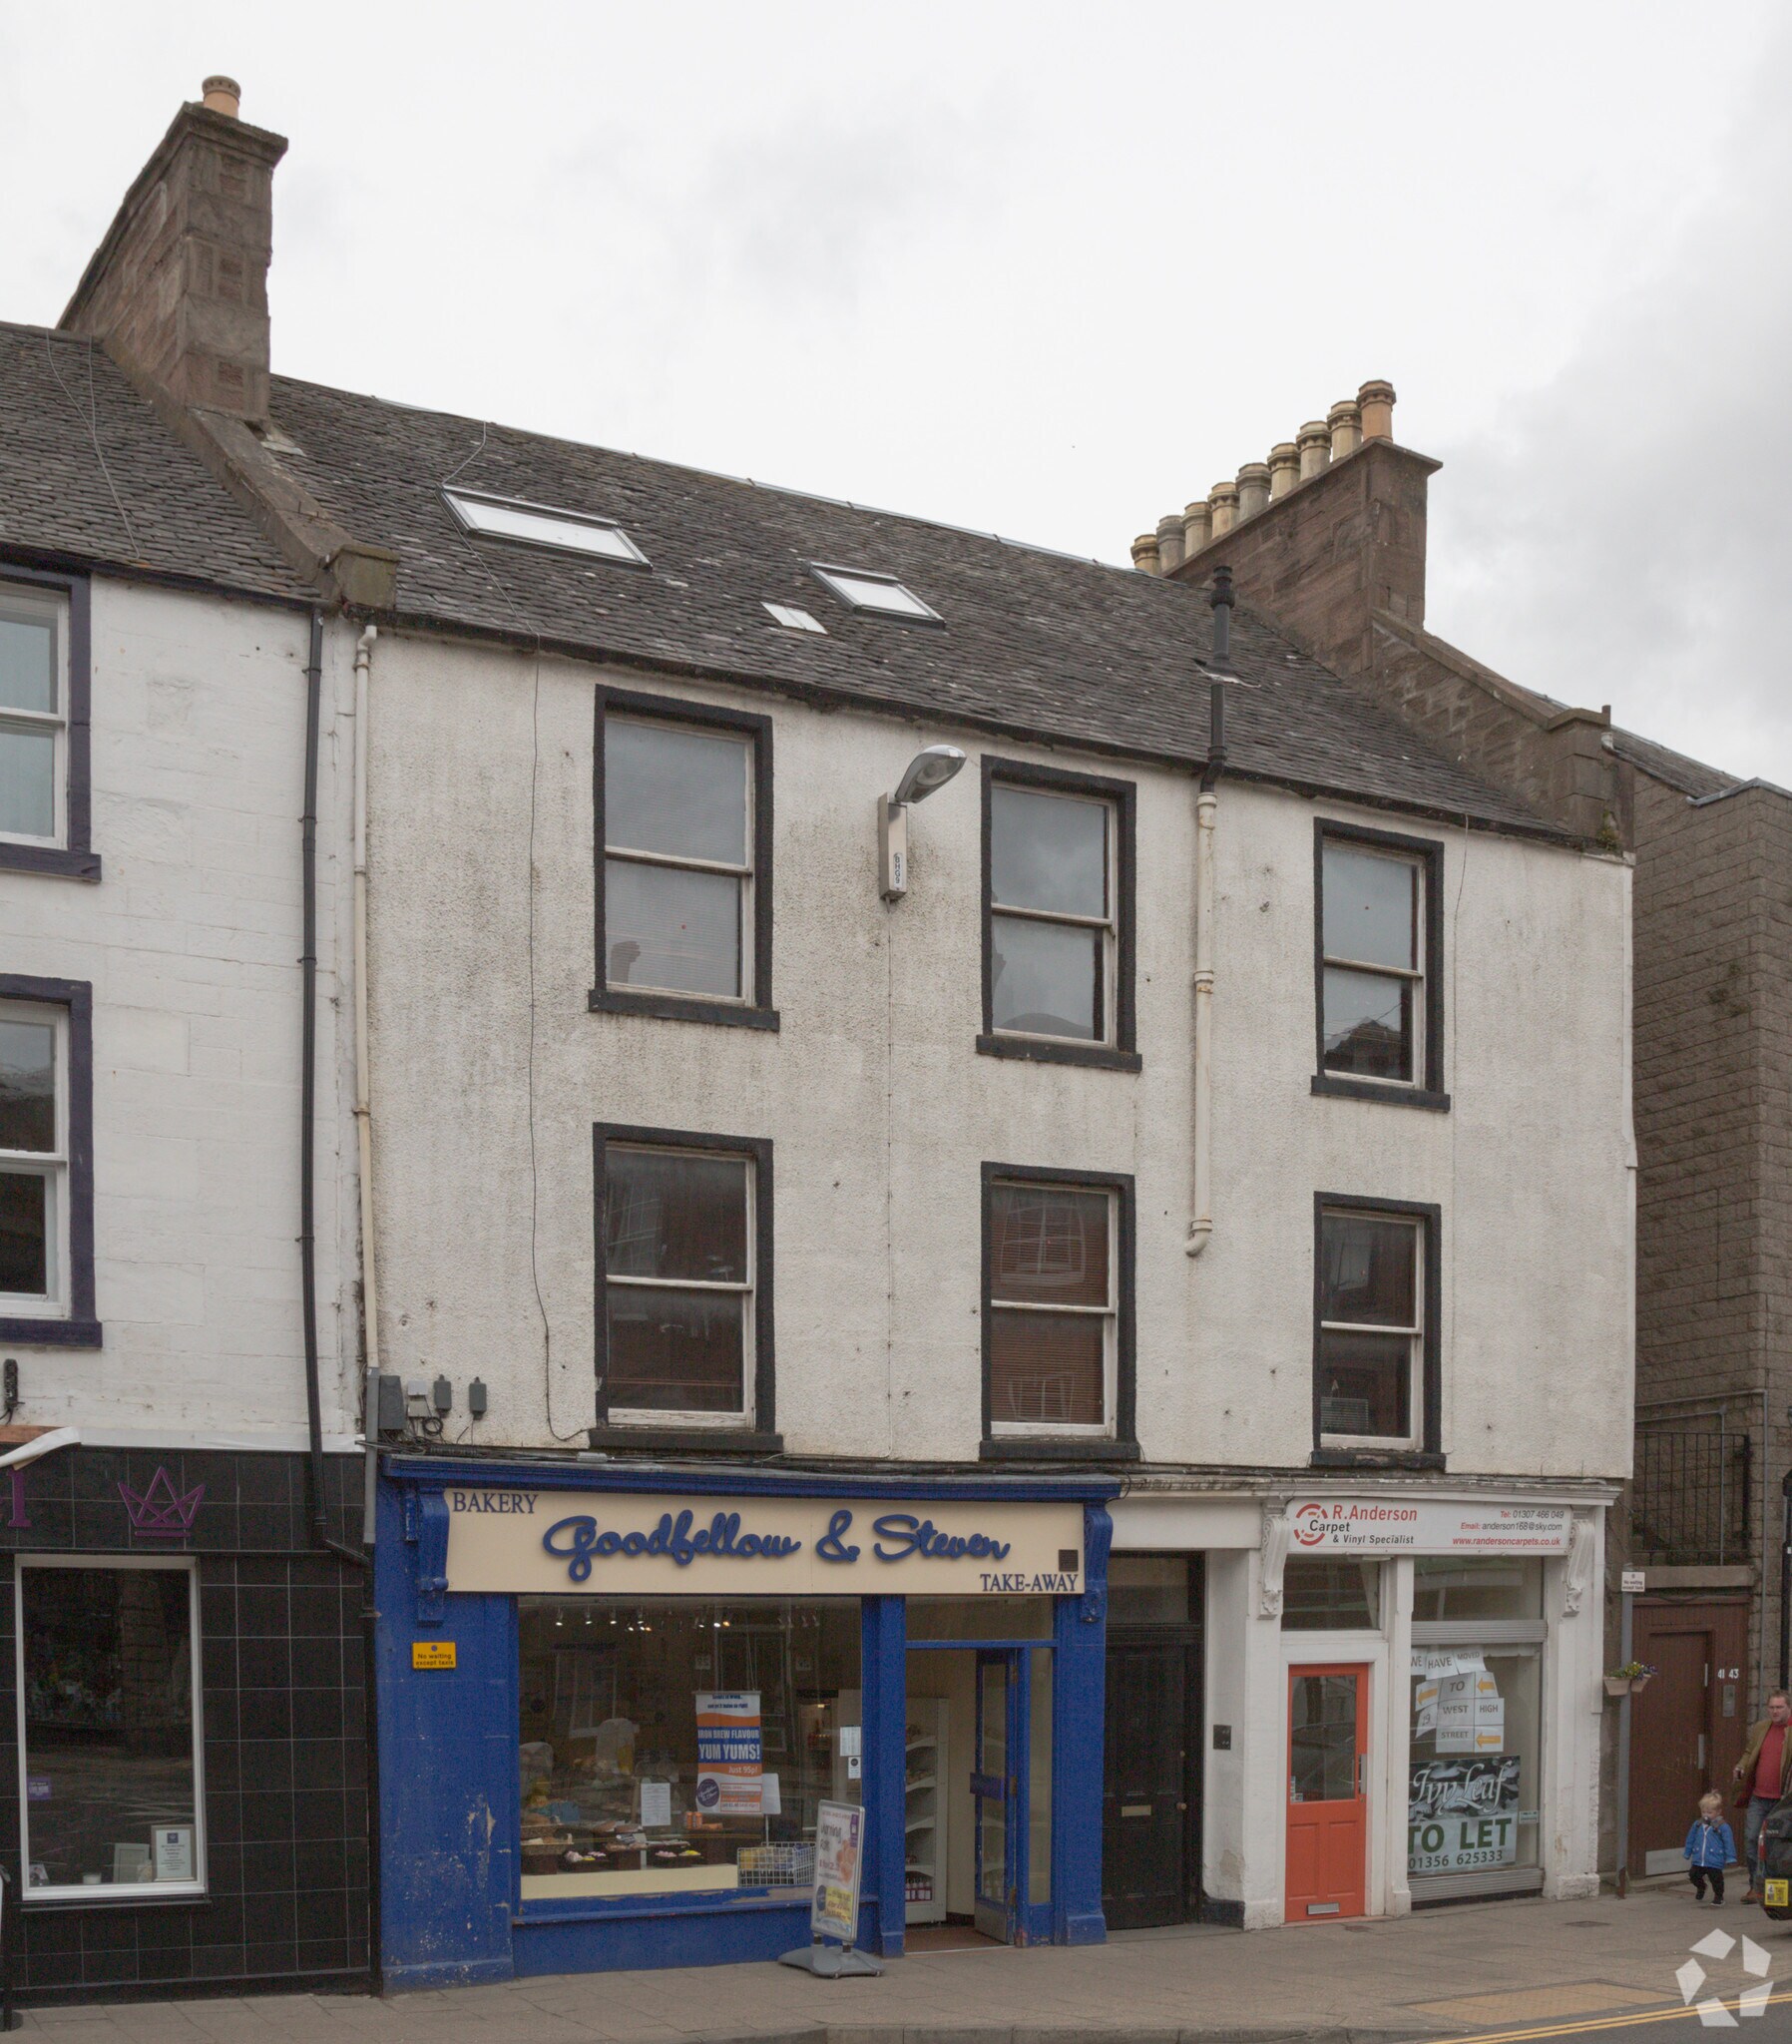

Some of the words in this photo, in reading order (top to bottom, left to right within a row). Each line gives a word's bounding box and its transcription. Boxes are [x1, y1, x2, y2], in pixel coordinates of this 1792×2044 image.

[452, 1491, 539, 1514] BAKERY
[1309, 1519, 1350, 1534] Carpet
[542, 1509, 802, 1582] Goodfellow
[815, 1509, 861, 1563] &
[873, 1513, 1011, 1562] Steven
[1332, 1534, 1339, 1543] &
[1343, 1534, 1365, 1544] Vinyl
[1369, 1534, 1414, 1545] Specialist
[980, 1573, 1079, 1593] TAKE-AWAY
[1428, 1656, 1453, 1670] HAVE
[1457, 1651, 1481, 1660] MOVED
[1717, 1669, 1725, 1679] 41
[1728, 1668, 1739, 1679] 43
[1449, 1680, 1466, 1693] TO
[1443, 1705, 1469, 1715] WEST
[1479, 1704, 1499, 1714] HIGH
[698, 1729, 712, 1740] IRON
[713, 1729, 730, 1740] BREW
[731, 1729, 760, 1740] FLAVOUR
[1441, 1731, 1469, 1740] STREET
[699, 1744, 721, 1760] YUM
[723, 1744, 760, 1760] YUMS!
[1409, 1766, 1457, 1816] Ivy
[1456, 1761, 1513, 1815] Leaf
[1408, 1823, 1445, 1854] TO
[1460, 1817, 1512, 1850] LET
[1409, 1854, 1450, 1869] 01356
[1457, 1849, 1503, 1865] 625333
